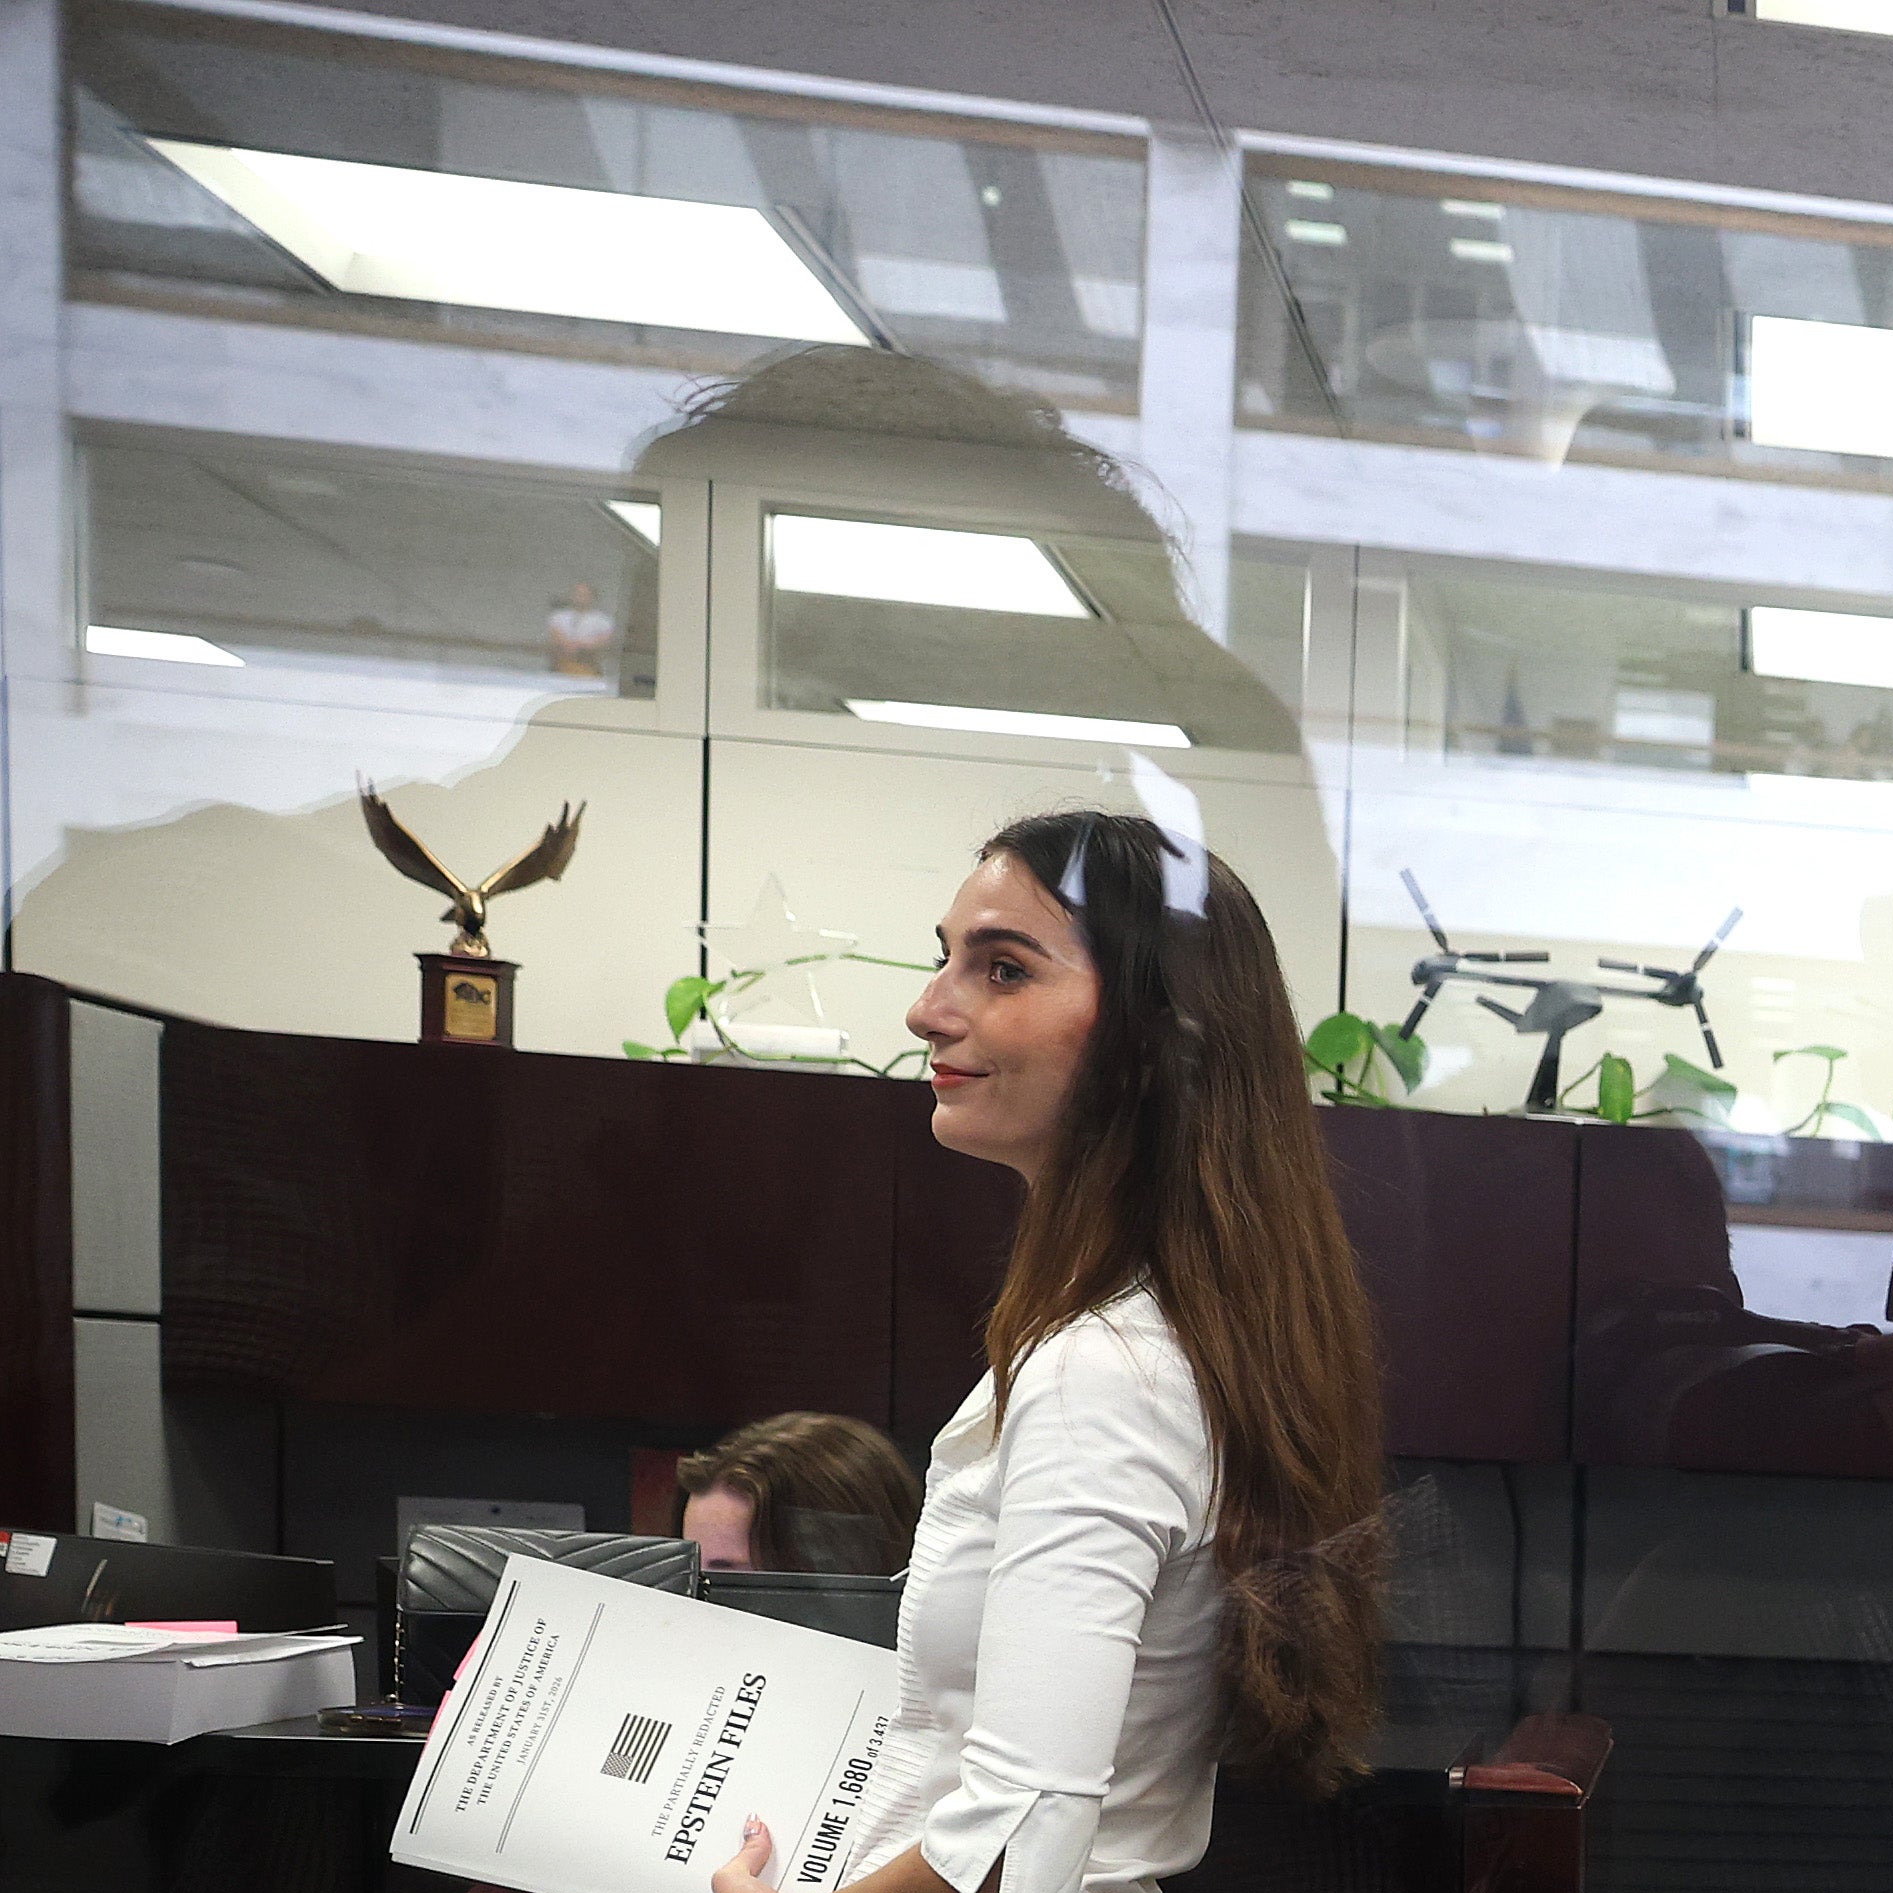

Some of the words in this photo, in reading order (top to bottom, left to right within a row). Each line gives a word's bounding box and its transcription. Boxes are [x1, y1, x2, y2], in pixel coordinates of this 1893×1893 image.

[455, 1786, 474, 1813] THE
[467, 1705, 510, 1784] DEPARTMENT
[504, 1686, 519, 1703] OF
[513, 1637, 540, 1686] JUSTICE
[534, 1617, 547, 1635] OF
[466, 1735, 477, 1747] AS
[472, 1689, 498, 1732] RELEASED
[494, 1676, 504, 1688] BY
[476, 1782, 494, 1806] THE
[487, 1740, 511, 1780] UNITED
[506, 1700, 532, 1739] STATES
[525, 1683, 538, 1699] OF
[533, 1634, 560, 1683] AMERICA
[516, 1722, 542, 1766] JANUARY
[547, 1676, 563, 1697] 2026
[651, 1815, 670, 1837] THE
[663, 1748, 699, 1811] PARTIALLY
[692, 1685, 726, 1747] REDACTED
[663, 1750, 735, 1865] EPSTEIN
[716, 1672, 767, 1749] FILES
[796, 1811, 851, 1883] VOLUME
[832, 1758, 874, 1807] 1,680
[866, 1746, 879, 1758] of
